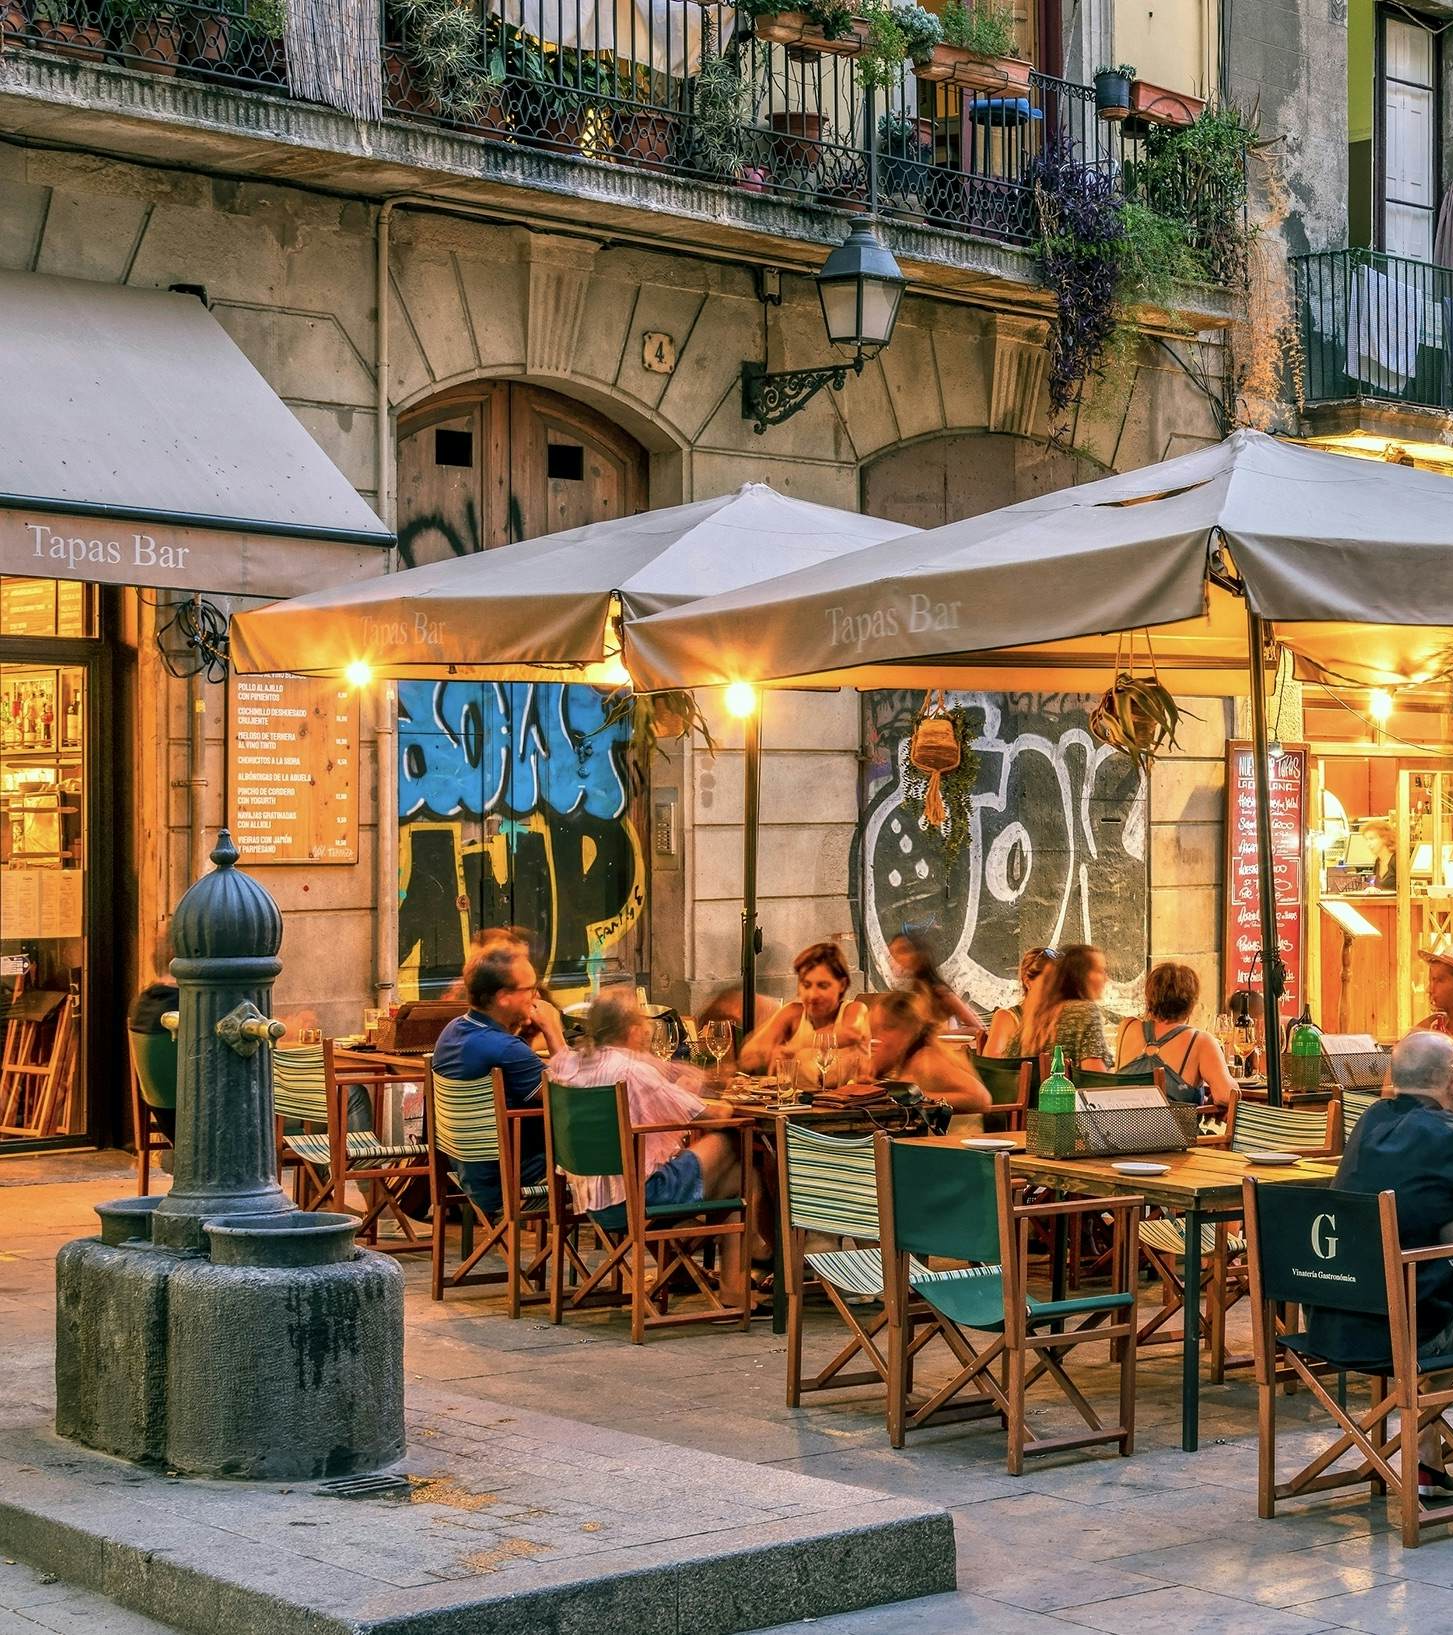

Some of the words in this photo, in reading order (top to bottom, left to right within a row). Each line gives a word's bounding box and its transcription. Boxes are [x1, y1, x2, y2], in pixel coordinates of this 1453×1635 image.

[655, 341, 665, 364] 4
[26, 524, 121, 569] Tapas
[132, 534, 190, 569] Bar
[360, 615, 408, 656] Tapas
[414, 611, 446, 645] Bar
[825, 606, 899, 653] Tapas
[909, 593, 962, 633] Bar
[238, 682, 256, 691] POLLO
[1311, 1213, 1339, 1260] G
